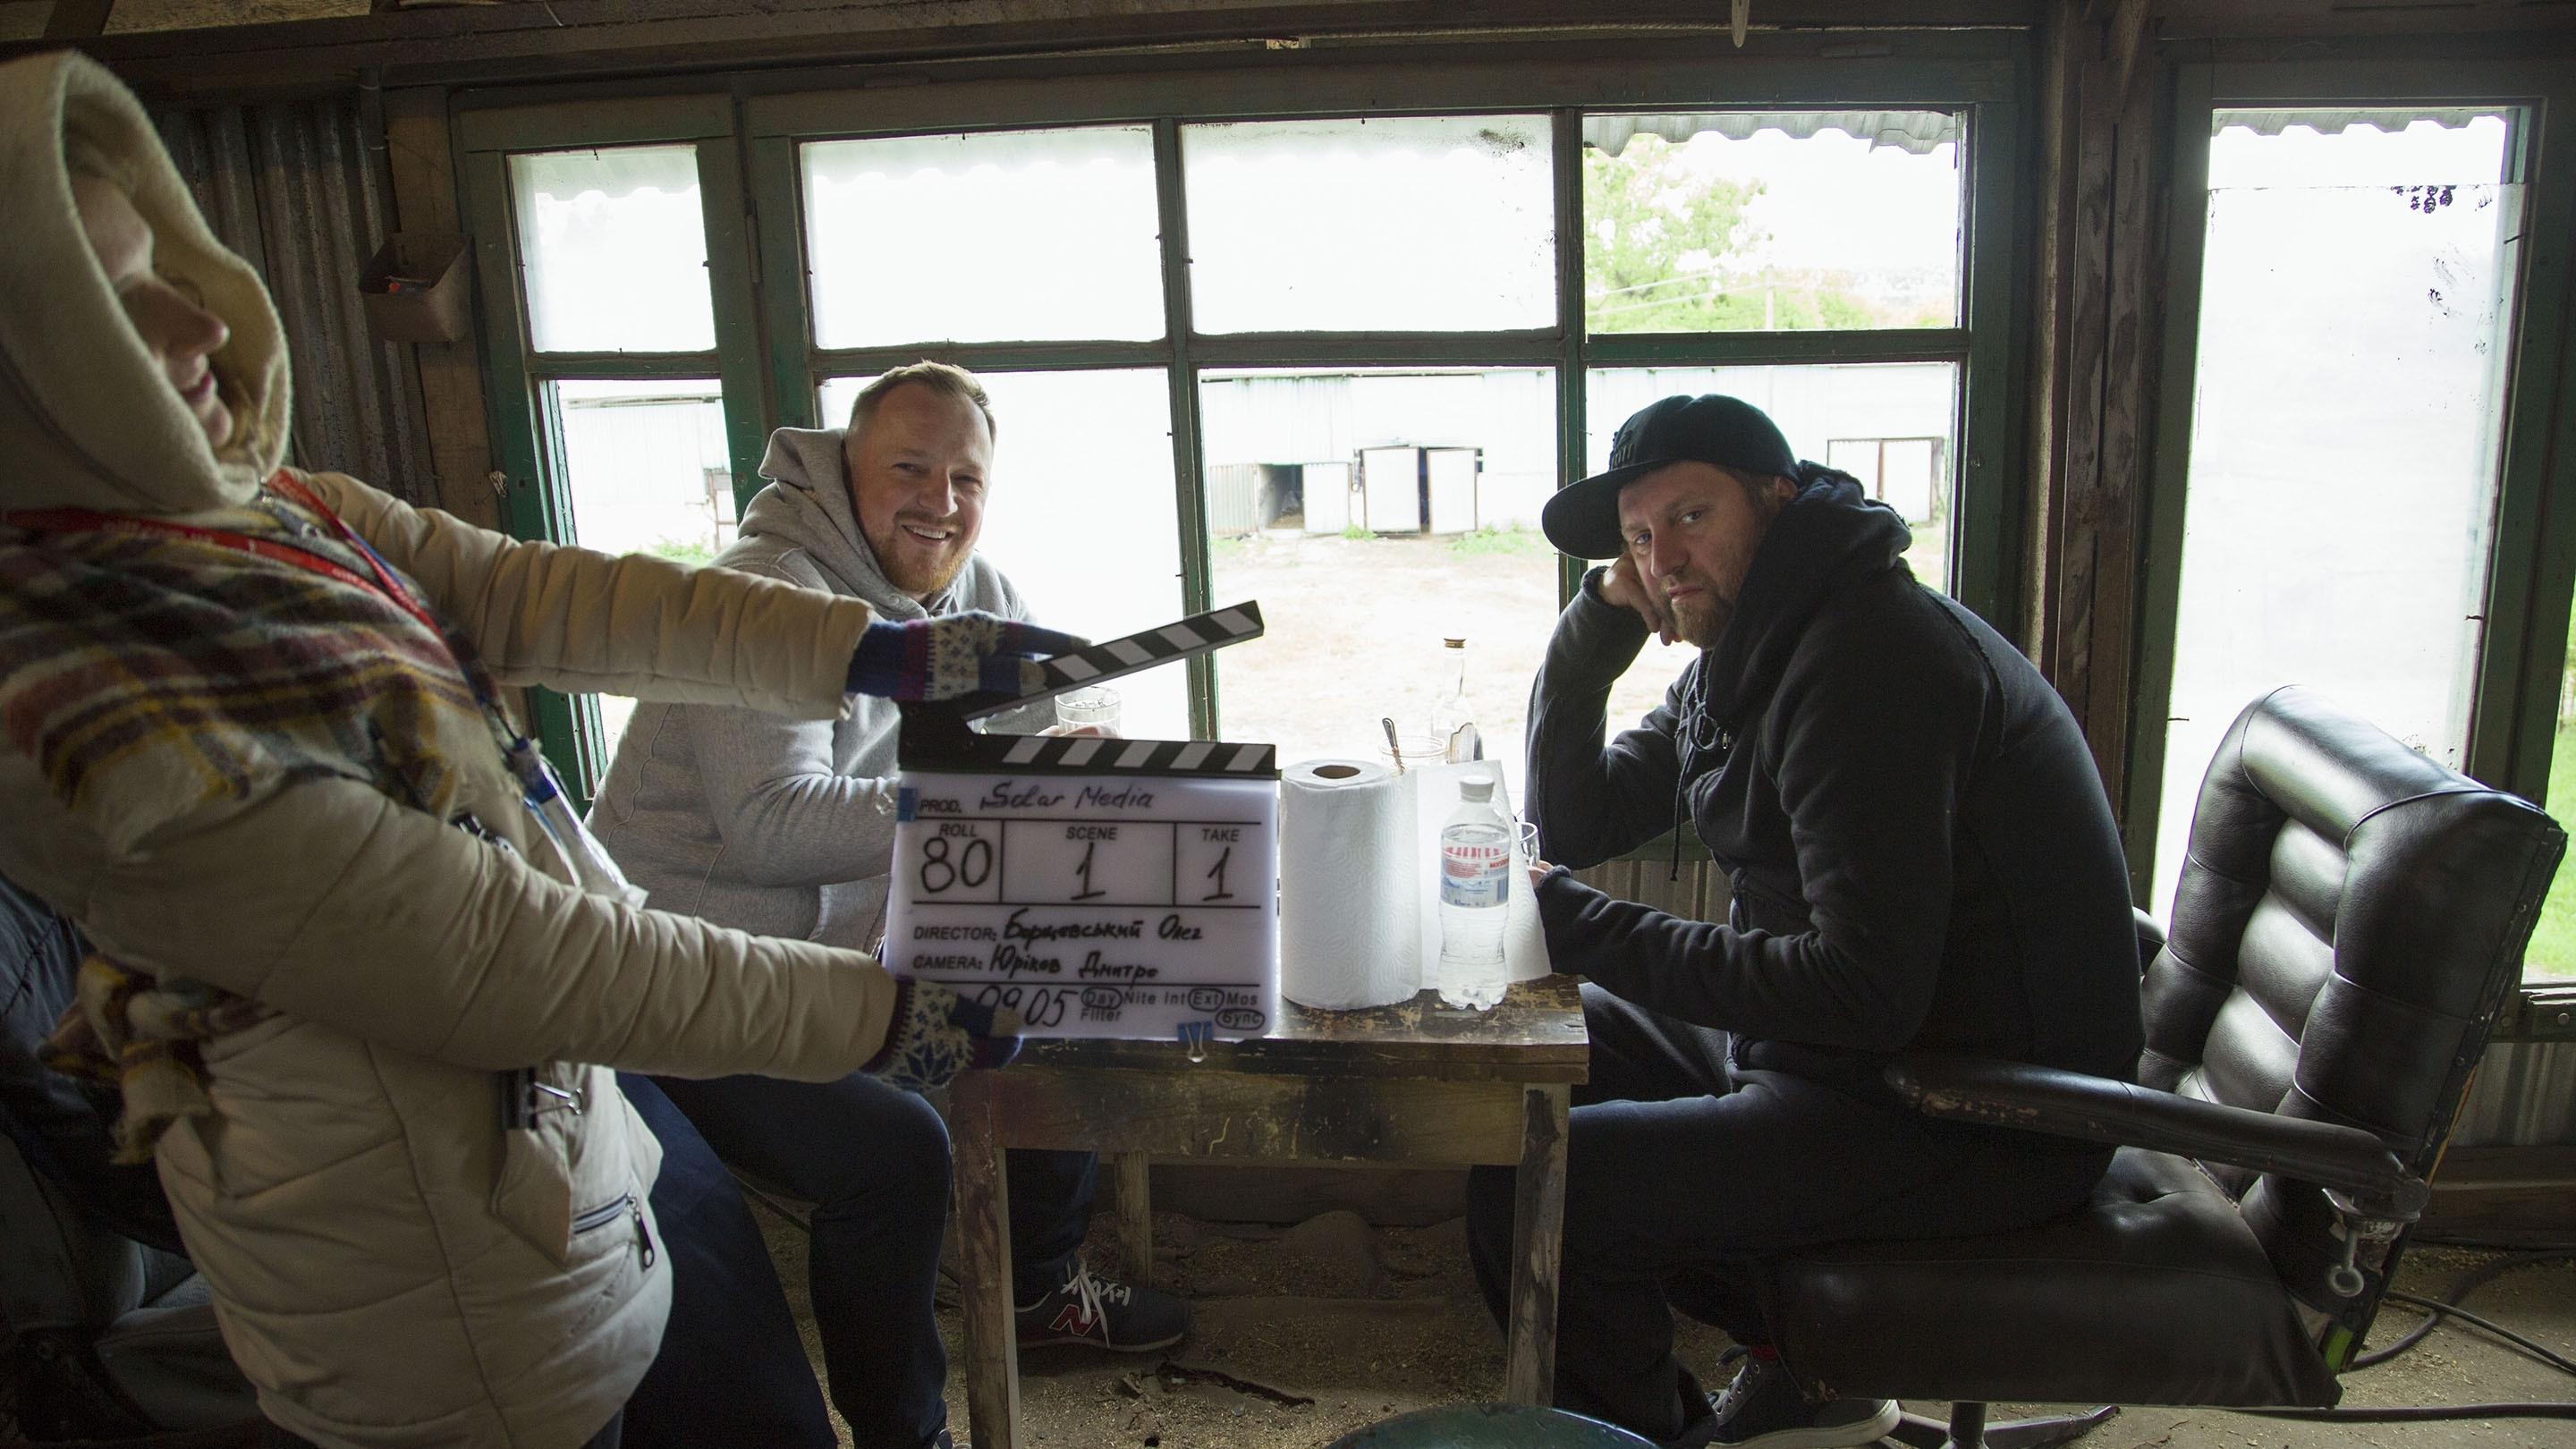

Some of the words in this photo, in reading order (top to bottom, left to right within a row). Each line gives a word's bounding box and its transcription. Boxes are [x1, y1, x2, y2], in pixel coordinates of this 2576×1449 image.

[979, 780, 1065, 810] Solar
[1074, 782, 1155, 809] Media
[918, 798, 962, 814] PROD.
[939, 823, 978, 838] ROLL
[1065, 826, 1117, 841] SCENE
[1201, 827, 1240, 843] TAKE
[920, 836, 993, 894] 80
[1071, 841, 1106, 901] 1
[1202, 846, 1233, 902] 1
[913, 925, 997, 942] DIRECTOR:
[1157, 913, 1203, 940] Олег
[912, 954, 983, 971] CAMERA:
[1078, 950, 1159, 990] Дмитро
[1085, 991, 1116, 1009] Day
[1123, 990, 1156, 1005] Nite
[1164, 991, 1186, 1005] Int
[1191, 991, 1219, 1007] Ext
[1225, 992, 1258, 1006] Mos
[1080, 1006, 1123, 1022] Filter
